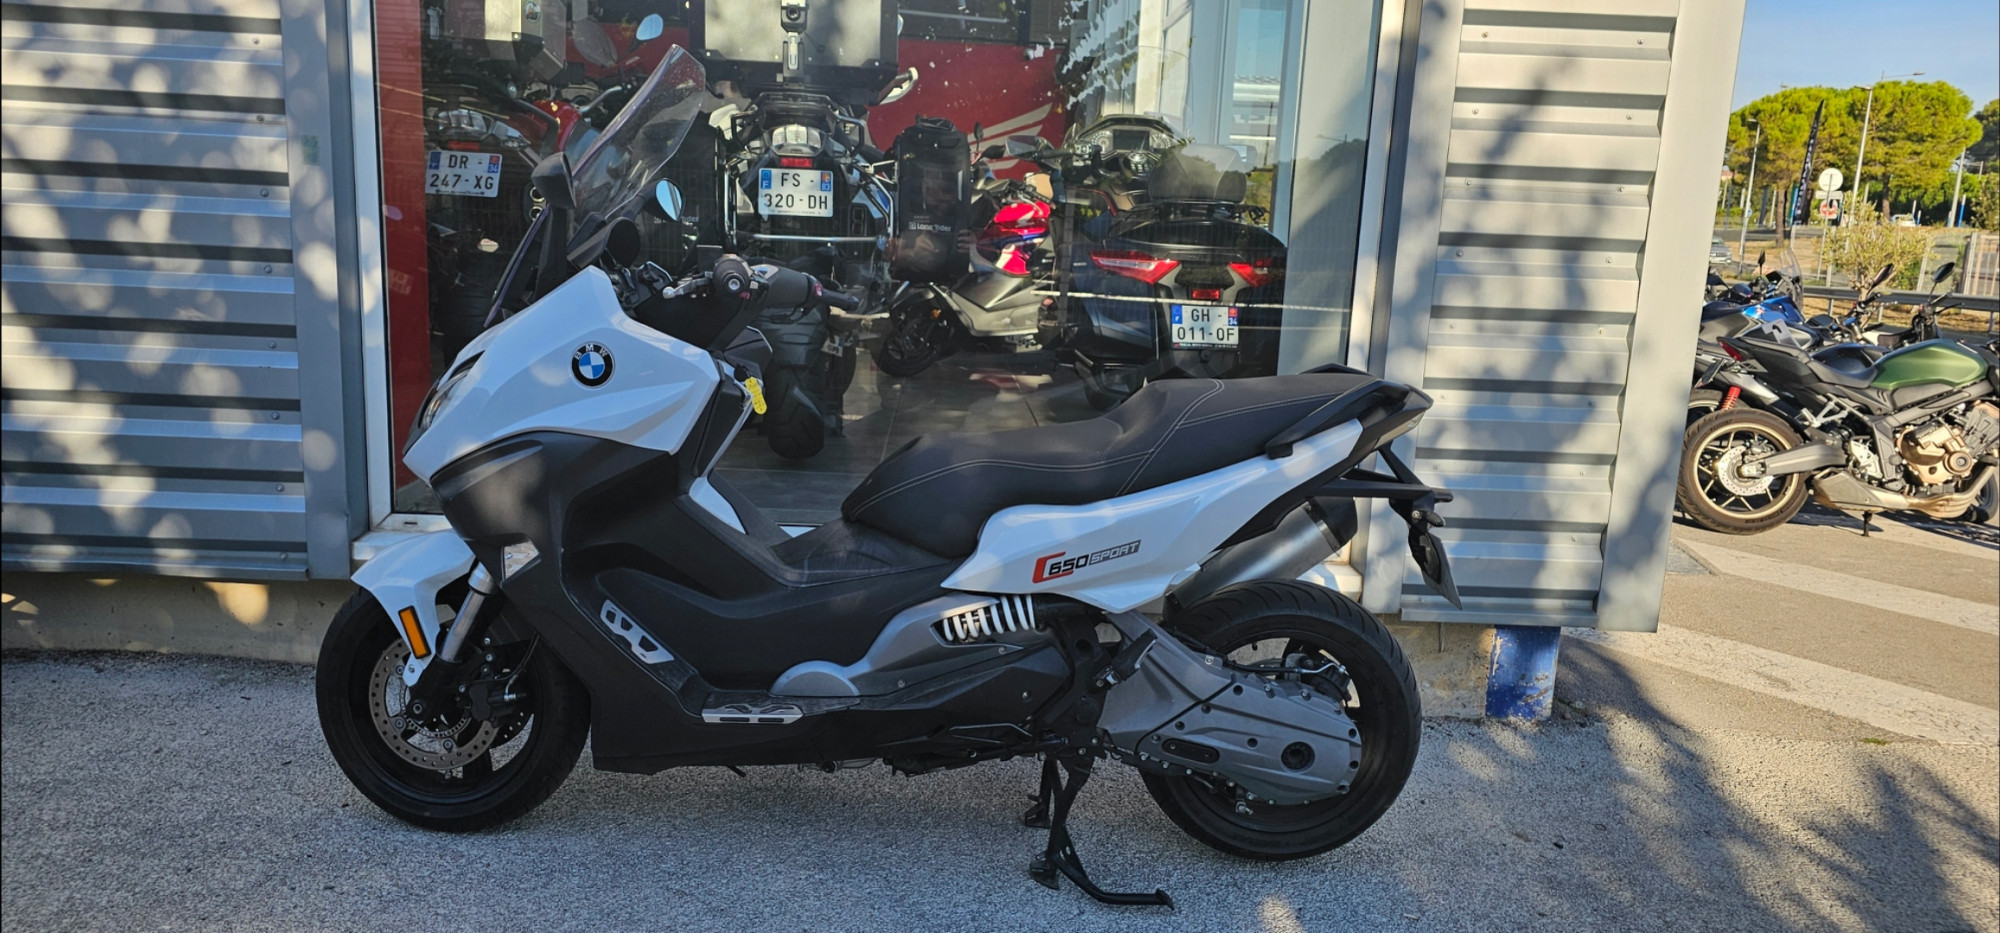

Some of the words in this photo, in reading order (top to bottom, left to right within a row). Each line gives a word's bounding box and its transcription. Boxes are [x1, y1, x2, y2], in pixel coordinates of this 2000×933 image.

[448, 154, 469, 169] DR
[488, 164, 498, 173] 34
[429, 173, 494, 190] 247-XG
[762, 180, 769, 189] F
[781, 172, 801, 187] FS
[763, 193, 828, 210] 320-DH
[1191, 308, 1210, 322] GH
[1229, 317, 1238, 325] 34
[574, 344, 610, 360] BMW
[1090, 540, 1140, 565] SPORT
